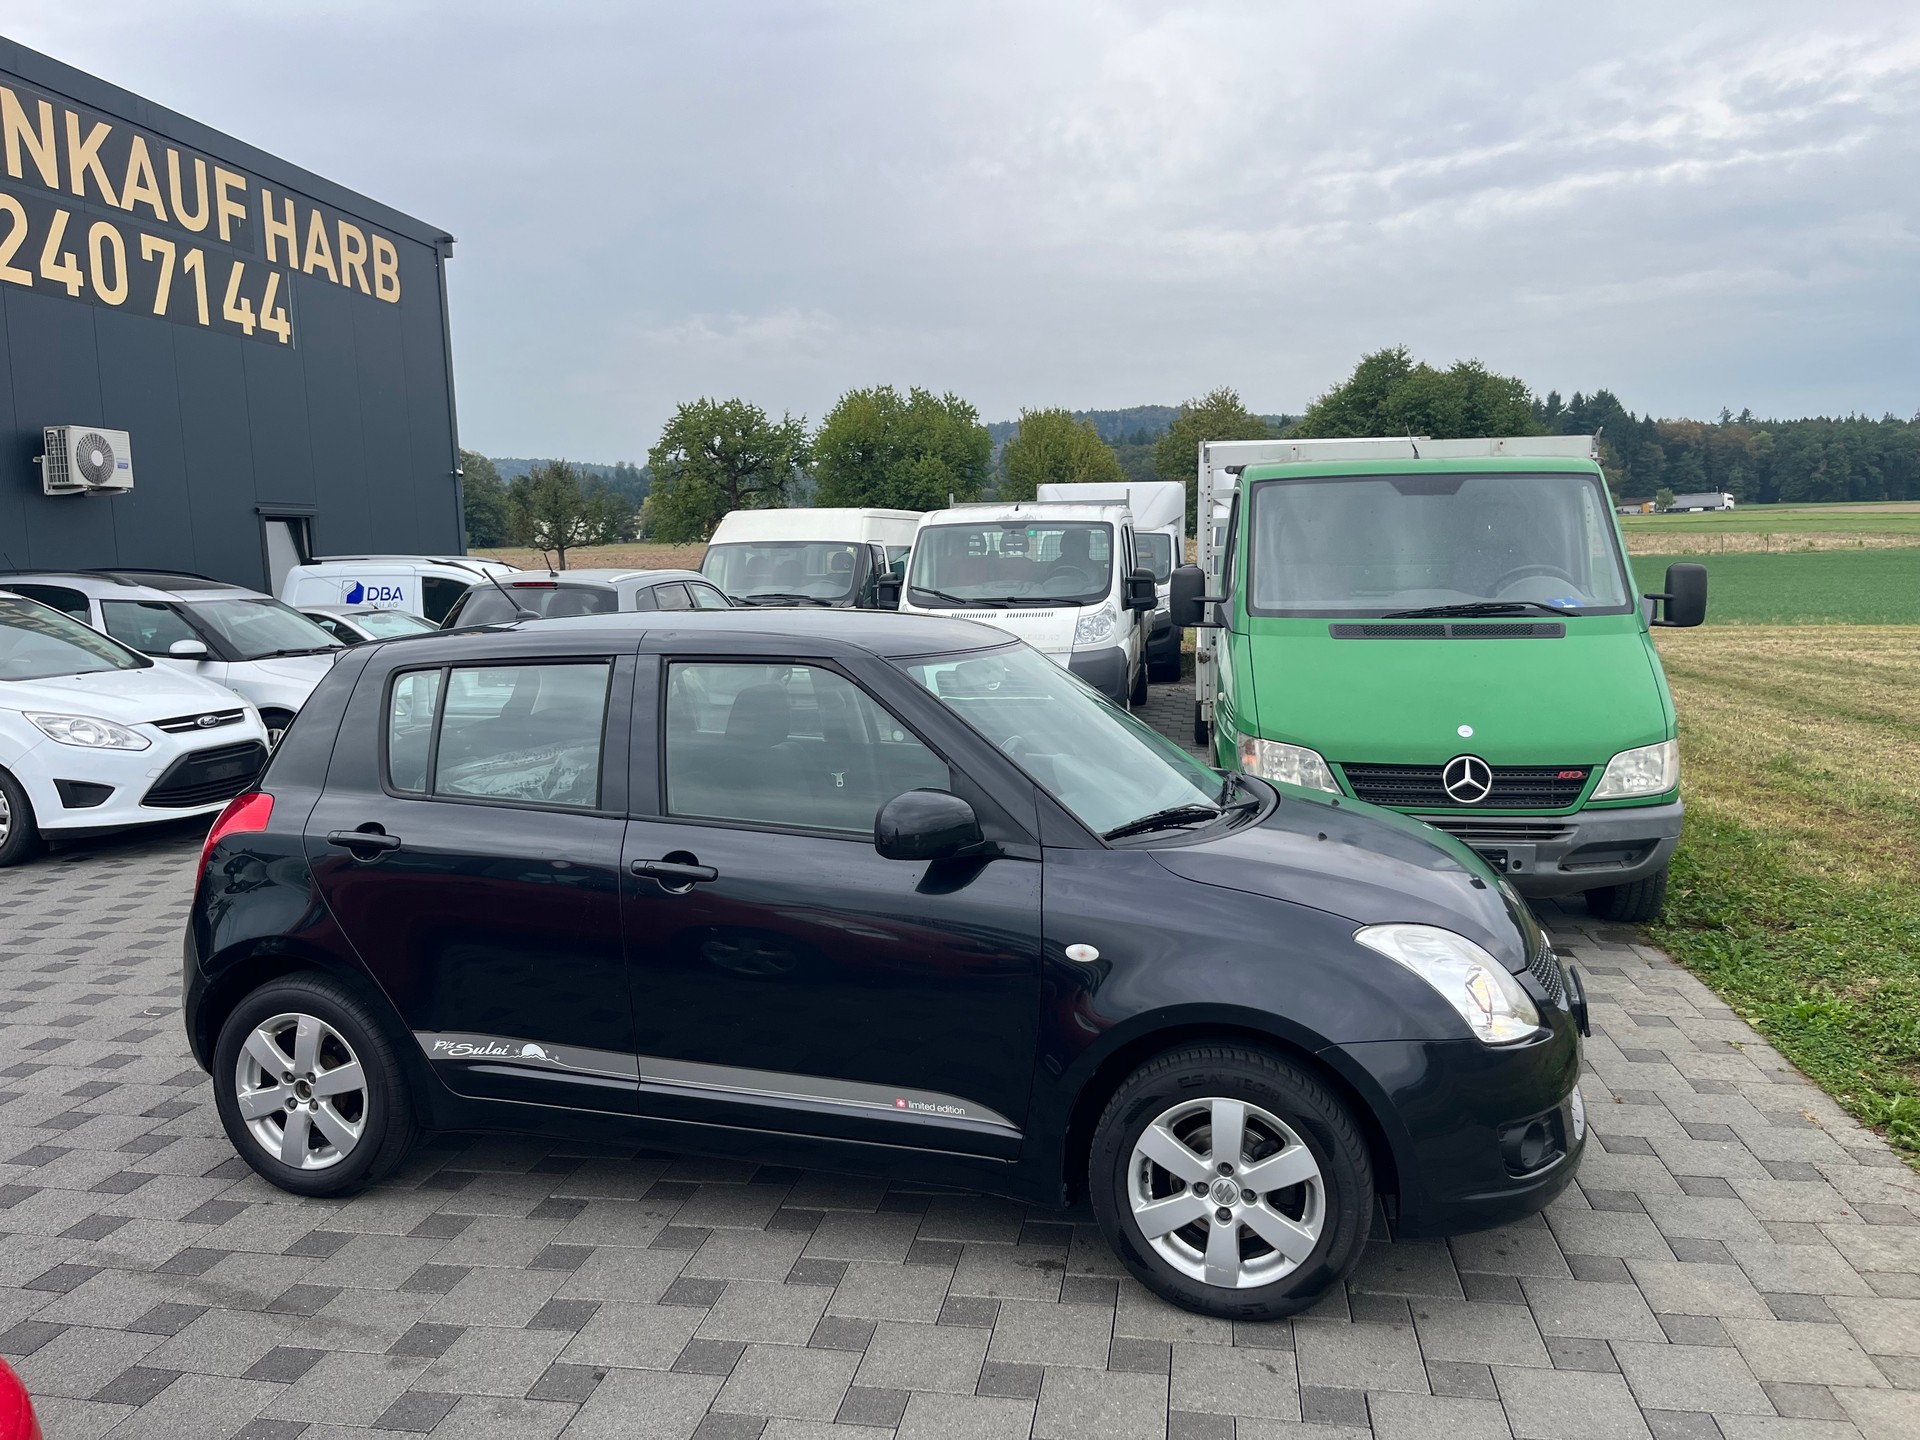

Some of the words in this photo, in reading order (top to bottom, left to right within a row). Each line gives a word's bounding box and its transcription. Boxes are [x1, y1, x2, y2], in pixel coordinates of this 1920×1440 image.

[0, 85, 247, 242] NKAUF
[261, 188, 401, 304] HARB
[367, 586, 403, 601] DBA
[448, 1041, 510, 1056] Sulai
[908, 1100, 936, 1111] limited
[937, 1105, 966, 1115] edition
